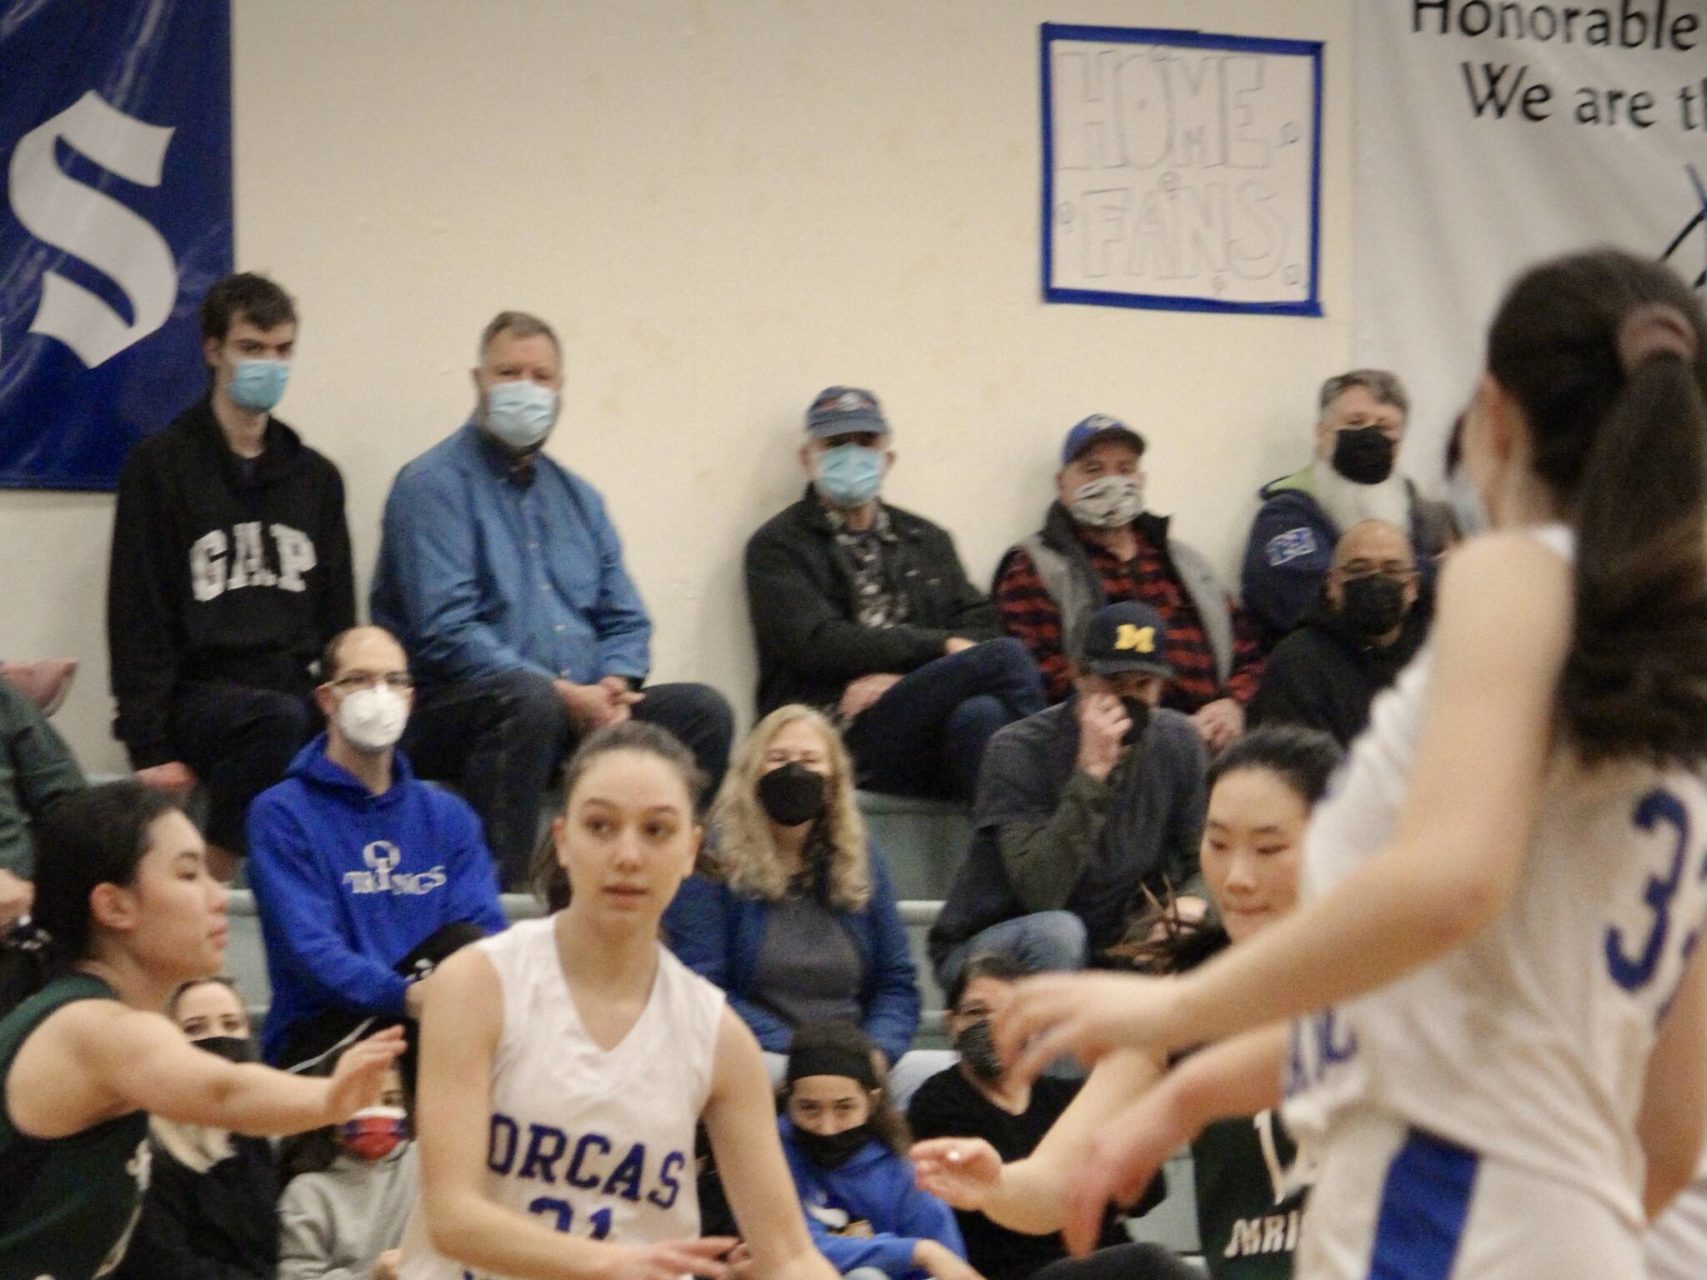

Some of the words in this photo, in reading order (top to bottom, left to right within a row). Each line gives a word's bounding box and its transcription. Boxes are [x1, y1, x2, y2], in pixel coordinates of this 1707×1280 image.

[1411, 0, 1699, 50] Honorable
[1053, 51, 1271, 171] HOME
[1459, 61, 1552, 121] We
[1574, 87, 1656, 128] are
[9, 90, 178, 369] S
[1081, 179, 1287, 281] FANS
[190, 522, 317, 601] GAP
[1115, 624, 1155, 653] M
[487, 1113, 685, 1210] ORCAS
